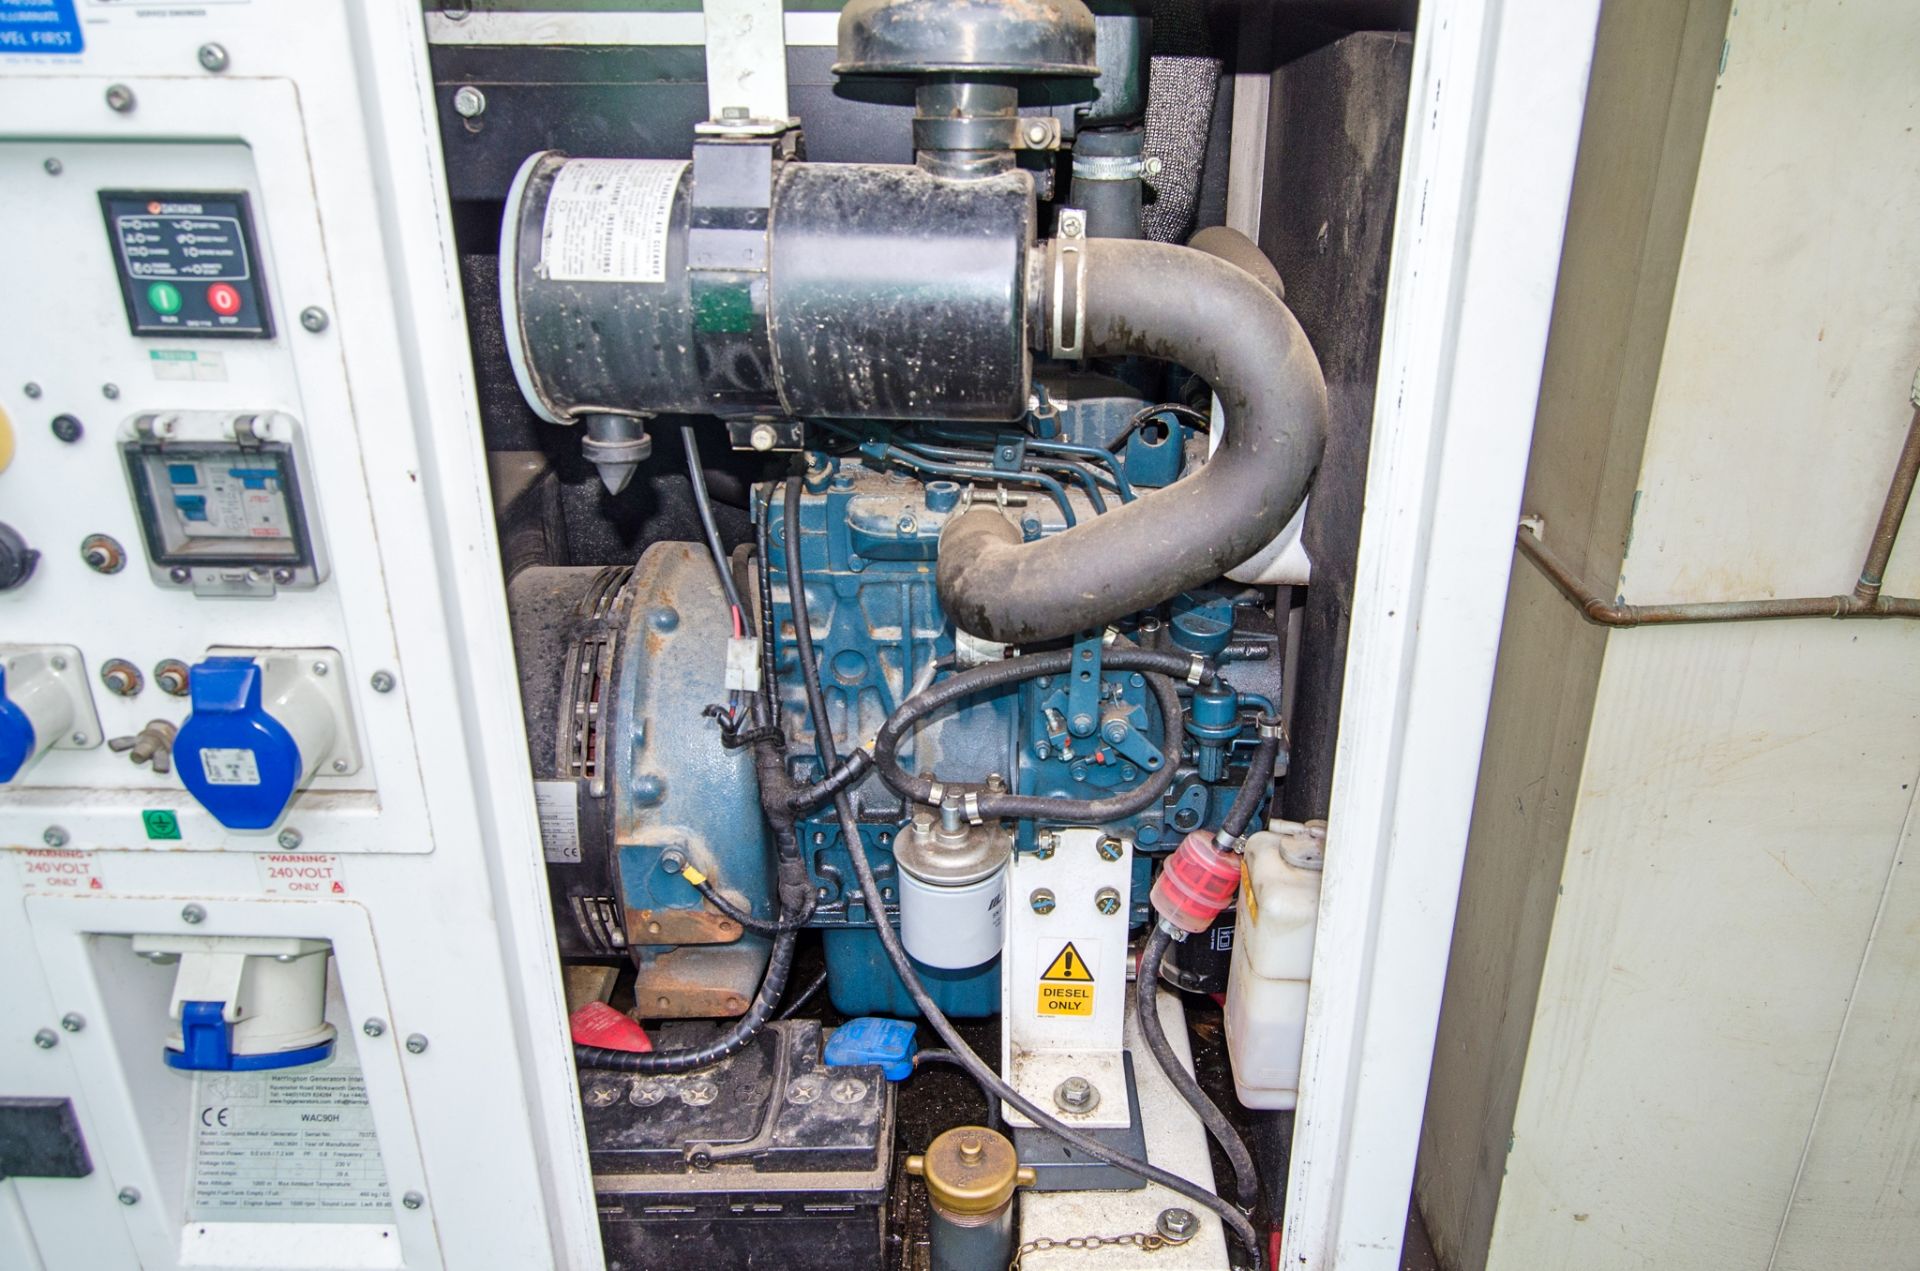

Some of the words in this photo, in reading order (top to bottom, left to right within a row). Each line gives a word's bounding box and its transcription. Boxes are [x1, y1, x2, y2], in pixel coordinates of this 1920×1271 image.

[654, 221, 662, 234] AIR
[602, 213, 616, 274] INSTRUCTIONS
[652, 240, 661, 276] CLEANER
[267, 855, 328, 863] WARNING
[46, 876, 78, 887] ONLY
[287, 881, 320, 892] ONLY
[1043, 988, 1090, 999] DIESEL
[1048, 1001, 1083, 1011] ONLY
[271, 1074, 308, 1084] Harrington
[309, 1075, 347, 1083] Generators
[300, 1113, 341, 1123] WAC90H
